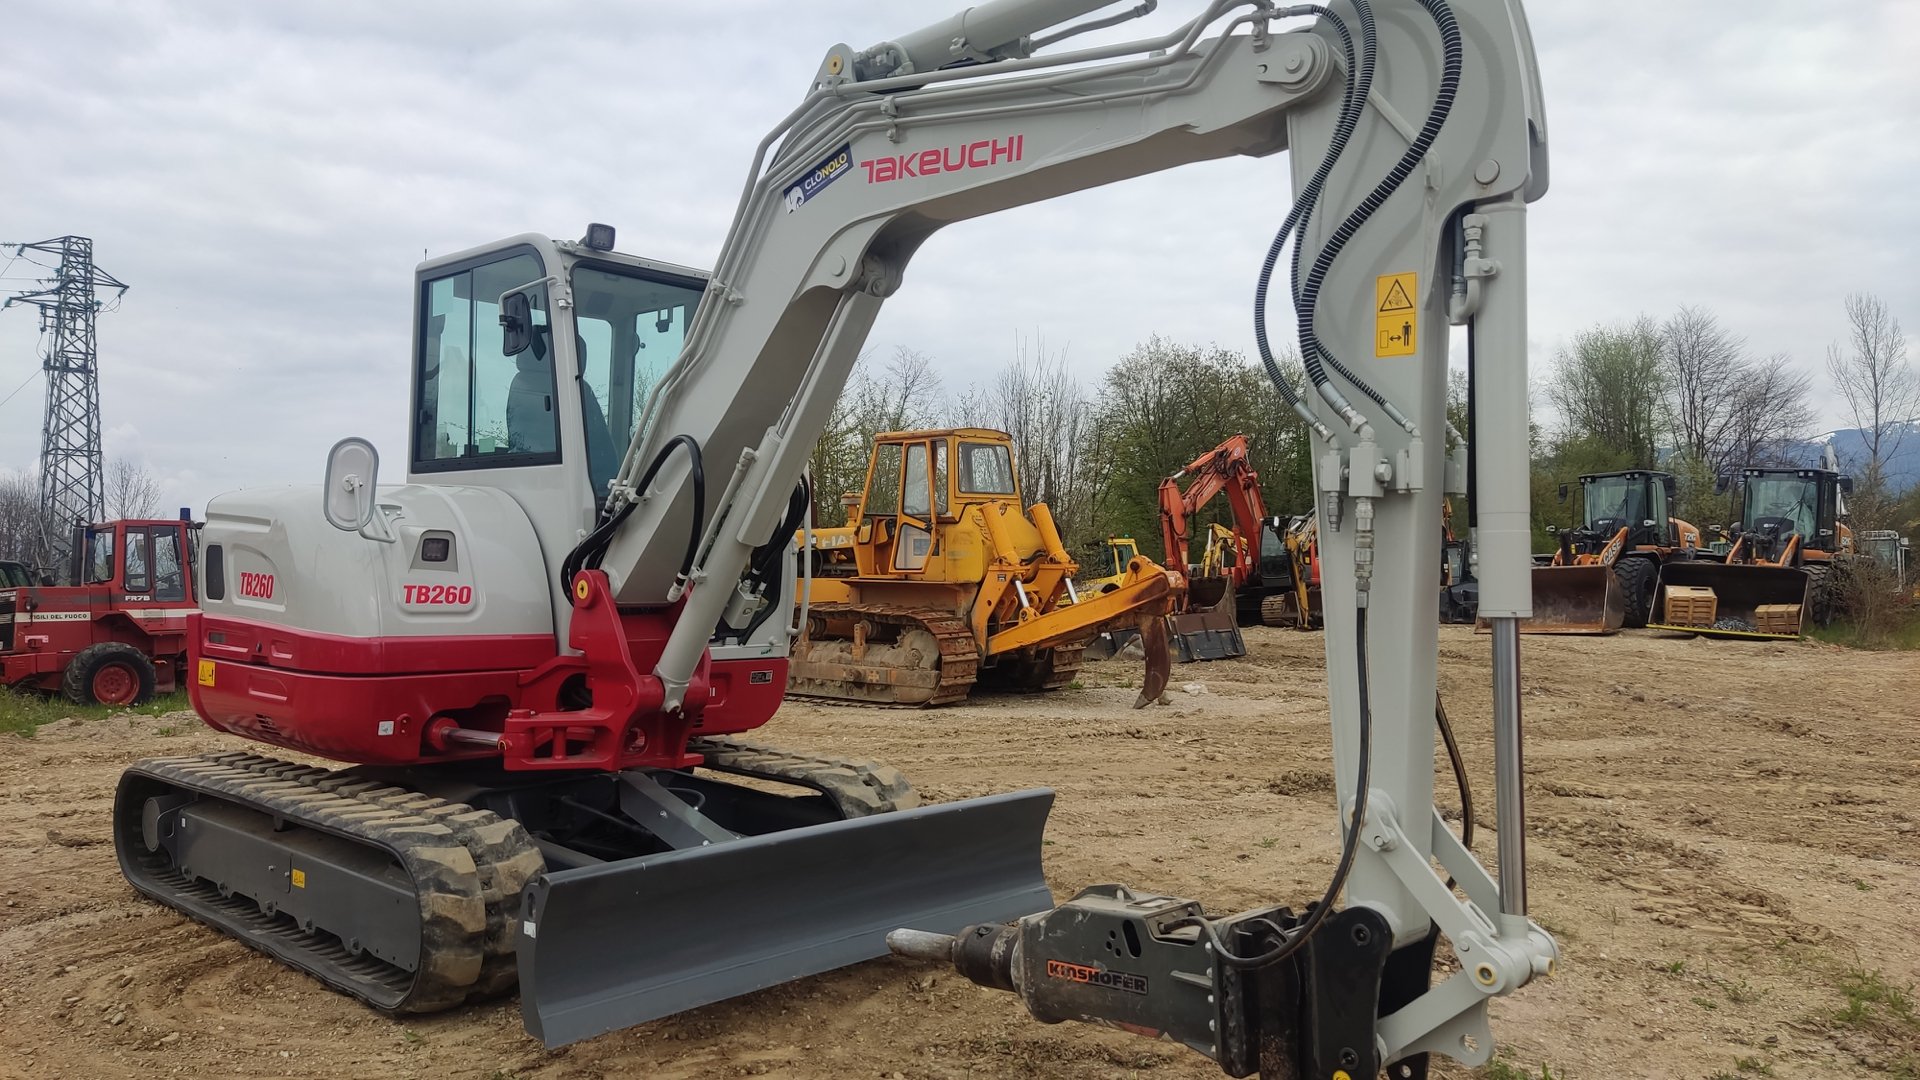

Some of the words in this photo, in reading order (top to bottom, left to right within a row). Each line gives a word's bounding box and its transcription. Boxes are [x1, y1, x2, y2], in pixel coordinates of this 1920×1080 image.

[860, 134, 1023, 184] TAKEUCHI
[1603, 537, 1621, 565] CASE
[240, 571, 275, 599] TB260
[403, 584, 472, 606] TB260
